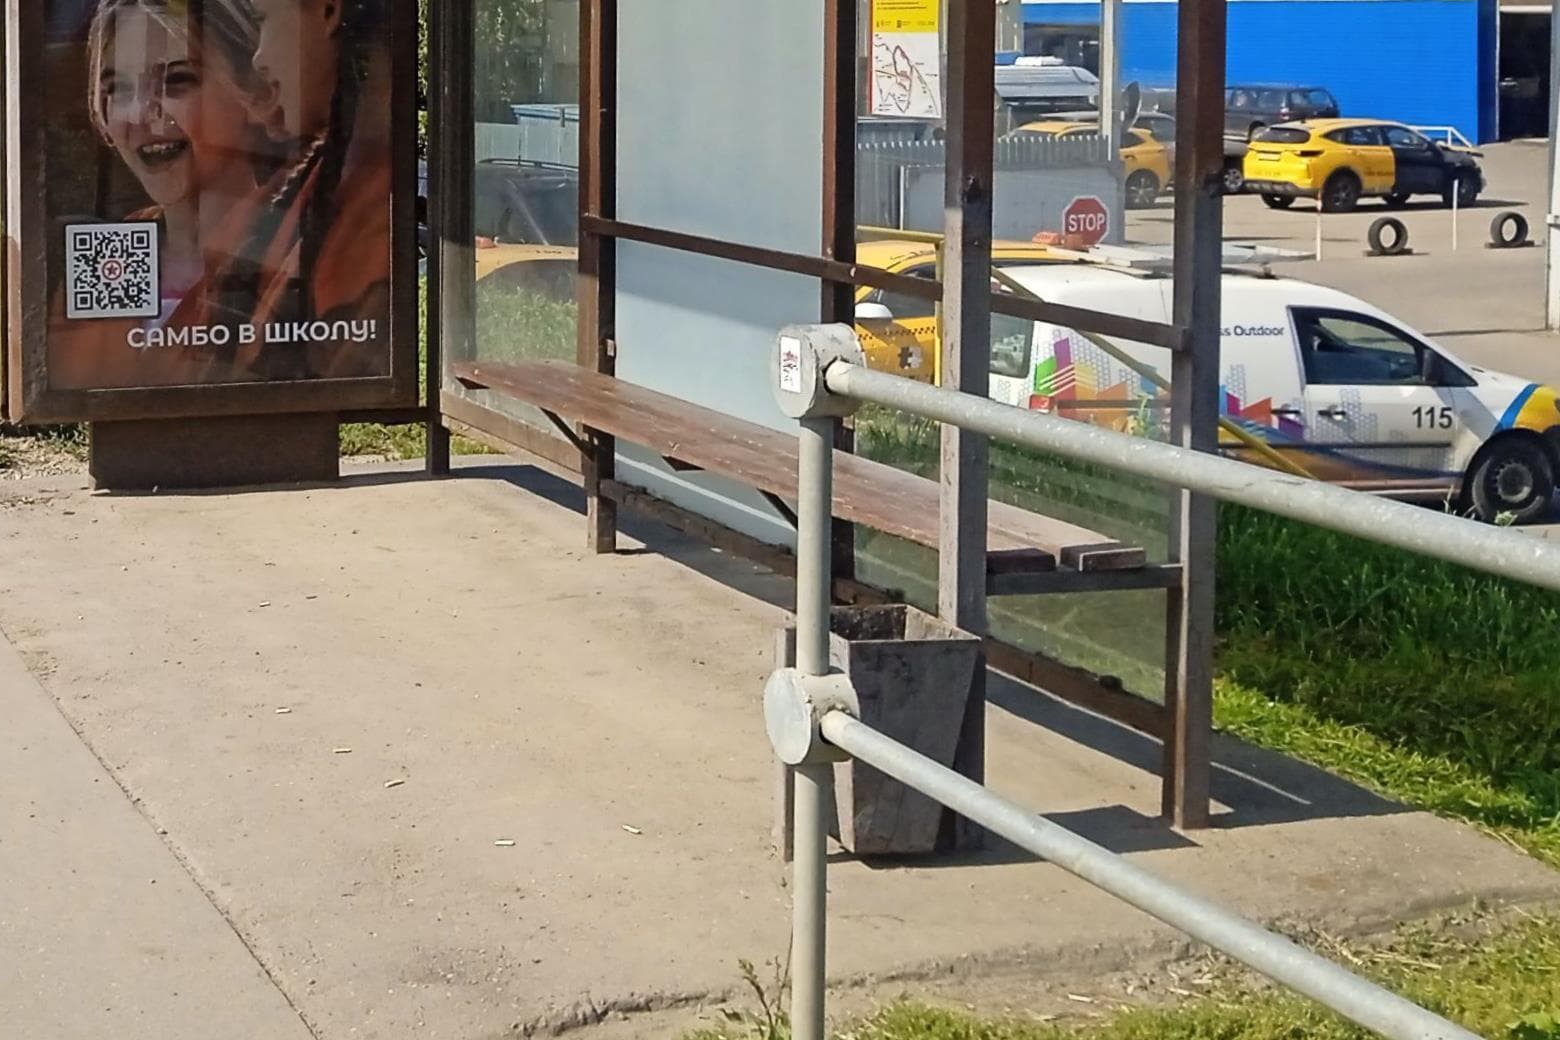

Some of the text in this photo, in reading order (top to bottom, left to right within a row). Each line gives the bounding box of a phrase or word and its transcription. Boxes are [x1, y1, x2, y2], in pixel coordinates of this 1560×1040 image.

[1068, 213, 1105, 232] STOP
[126, 319, 377, 348] САМБО В ШКОЛУ!
[1233, 324, 1284, 337] Outdoor
[1411, 406, 1453, 430] 115
